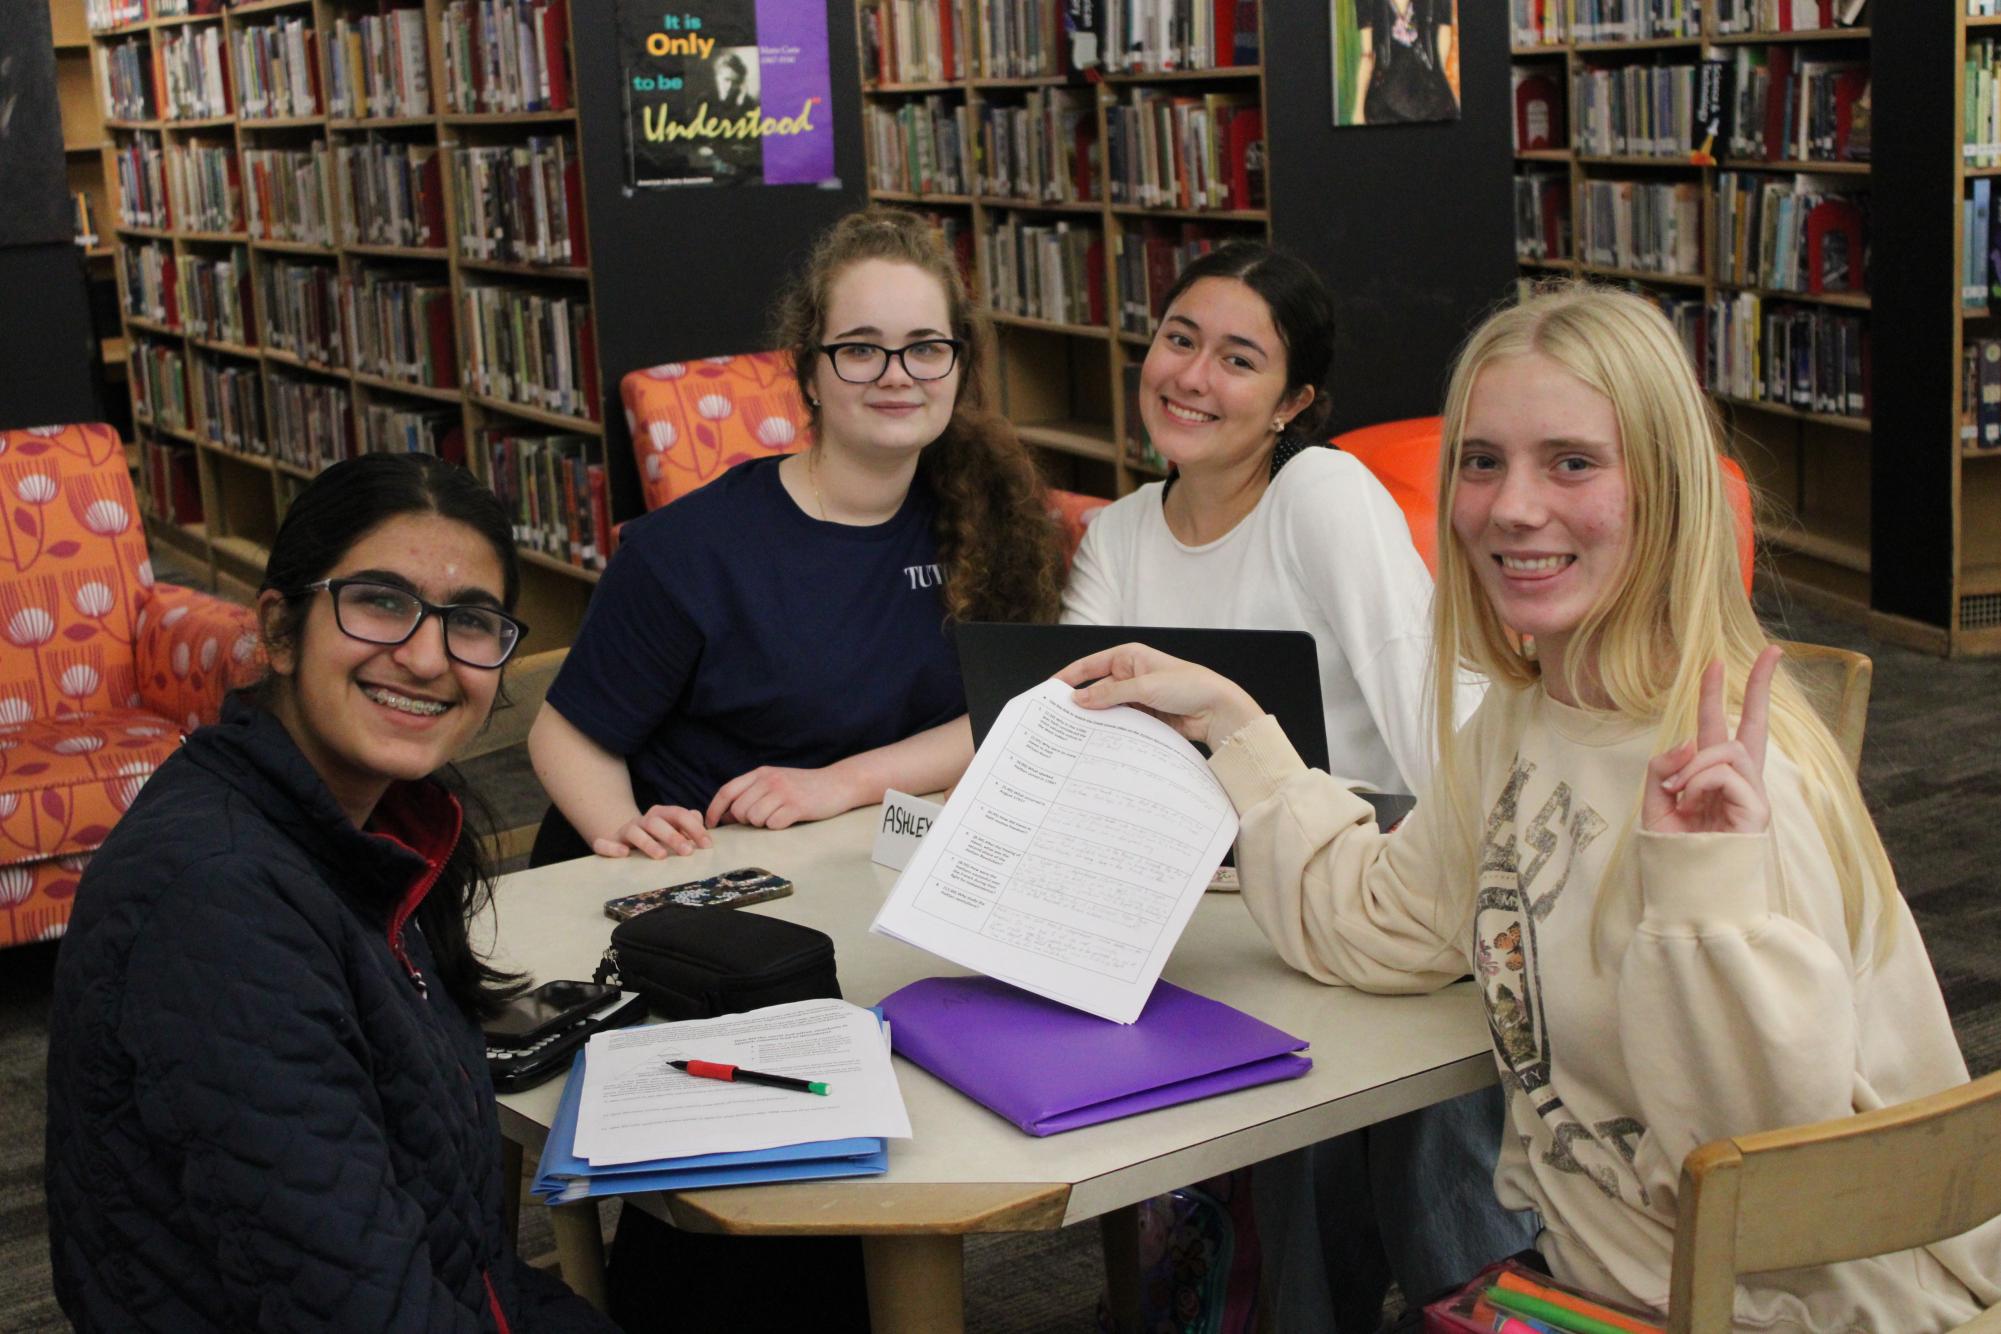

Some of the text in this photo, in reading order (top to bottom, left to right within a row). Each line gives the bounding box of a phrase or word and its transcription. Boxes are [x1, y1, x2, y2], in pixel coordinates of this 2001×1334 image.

[664, 14, 701, 30] It is
[646, 32, 715, 60] Only
[633, 75, 683, 91] to be
[643, 98, 814, 142] Understood
[882, 804, 934, 838] ASHLEY
